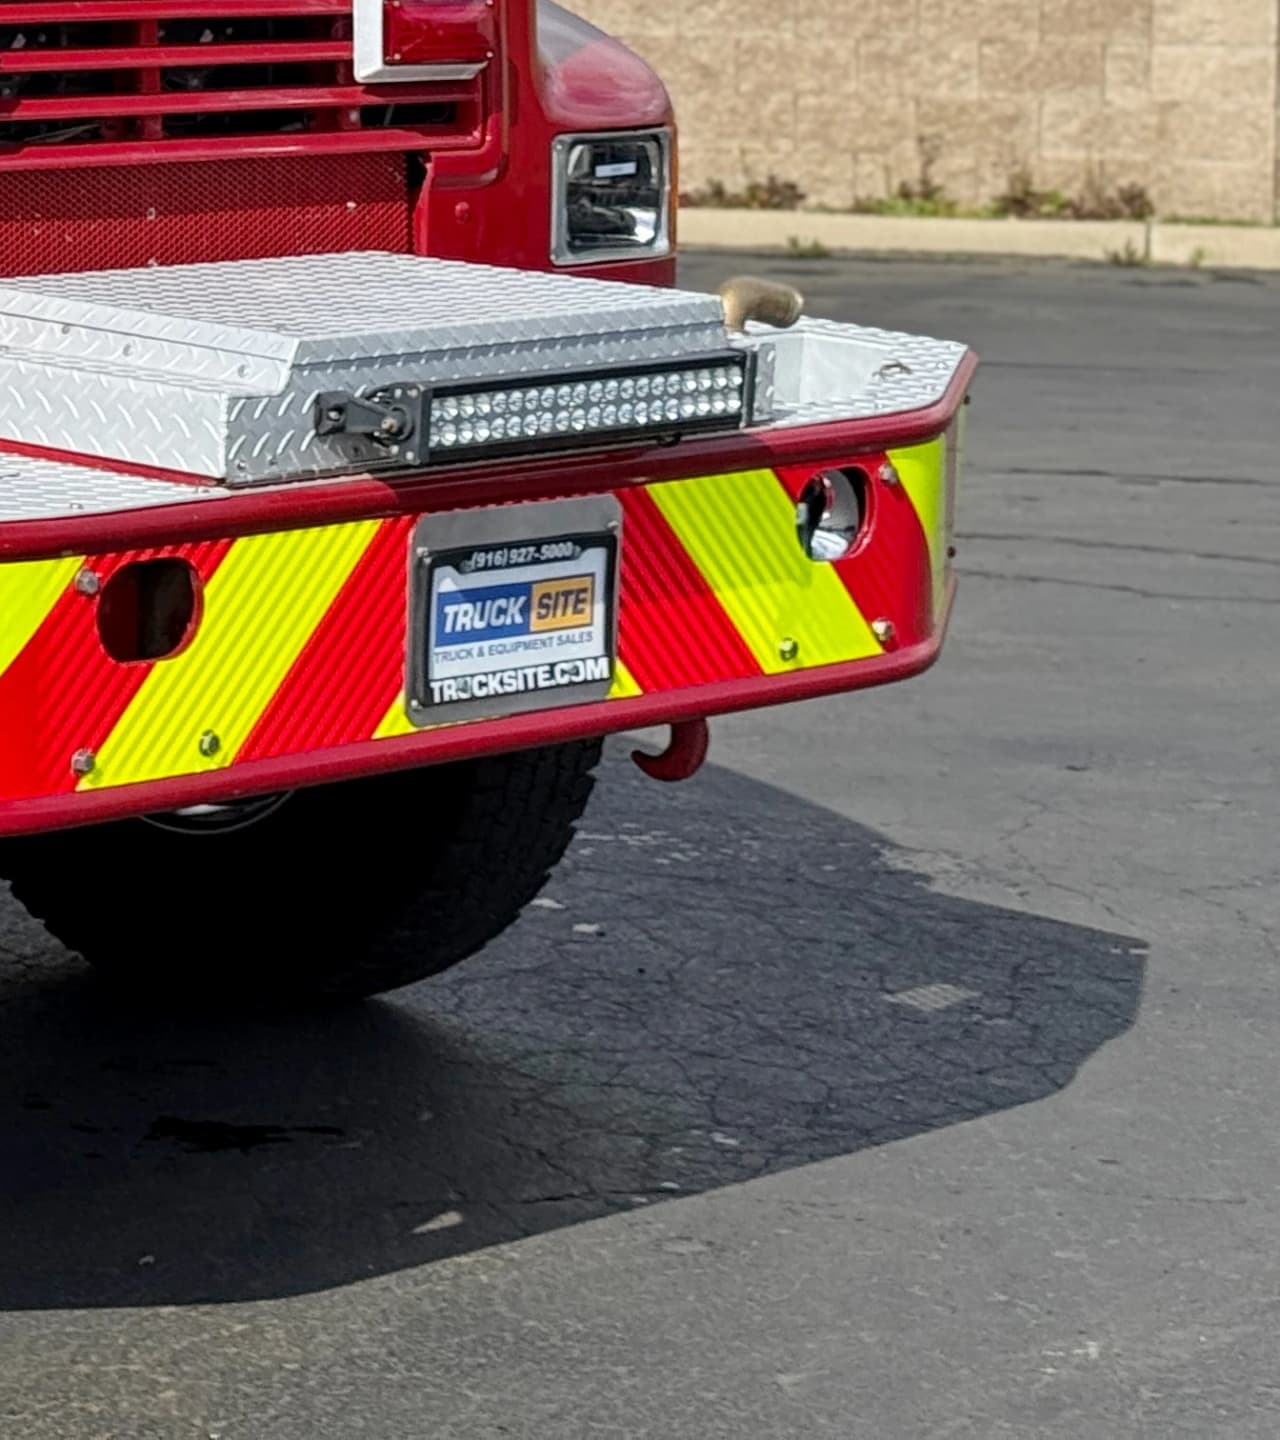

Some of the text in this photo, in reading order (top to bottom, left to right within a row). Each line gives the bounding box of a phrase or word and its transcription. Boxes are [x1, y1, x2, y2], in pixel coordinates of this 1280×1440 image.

[443, 587, 589, 633] TRUCK SITE
[434, 630, 594, 663] TRUCK & EQUIPMENT SALES
[430, 657, 610, 704] TRUCKSITE.COM
